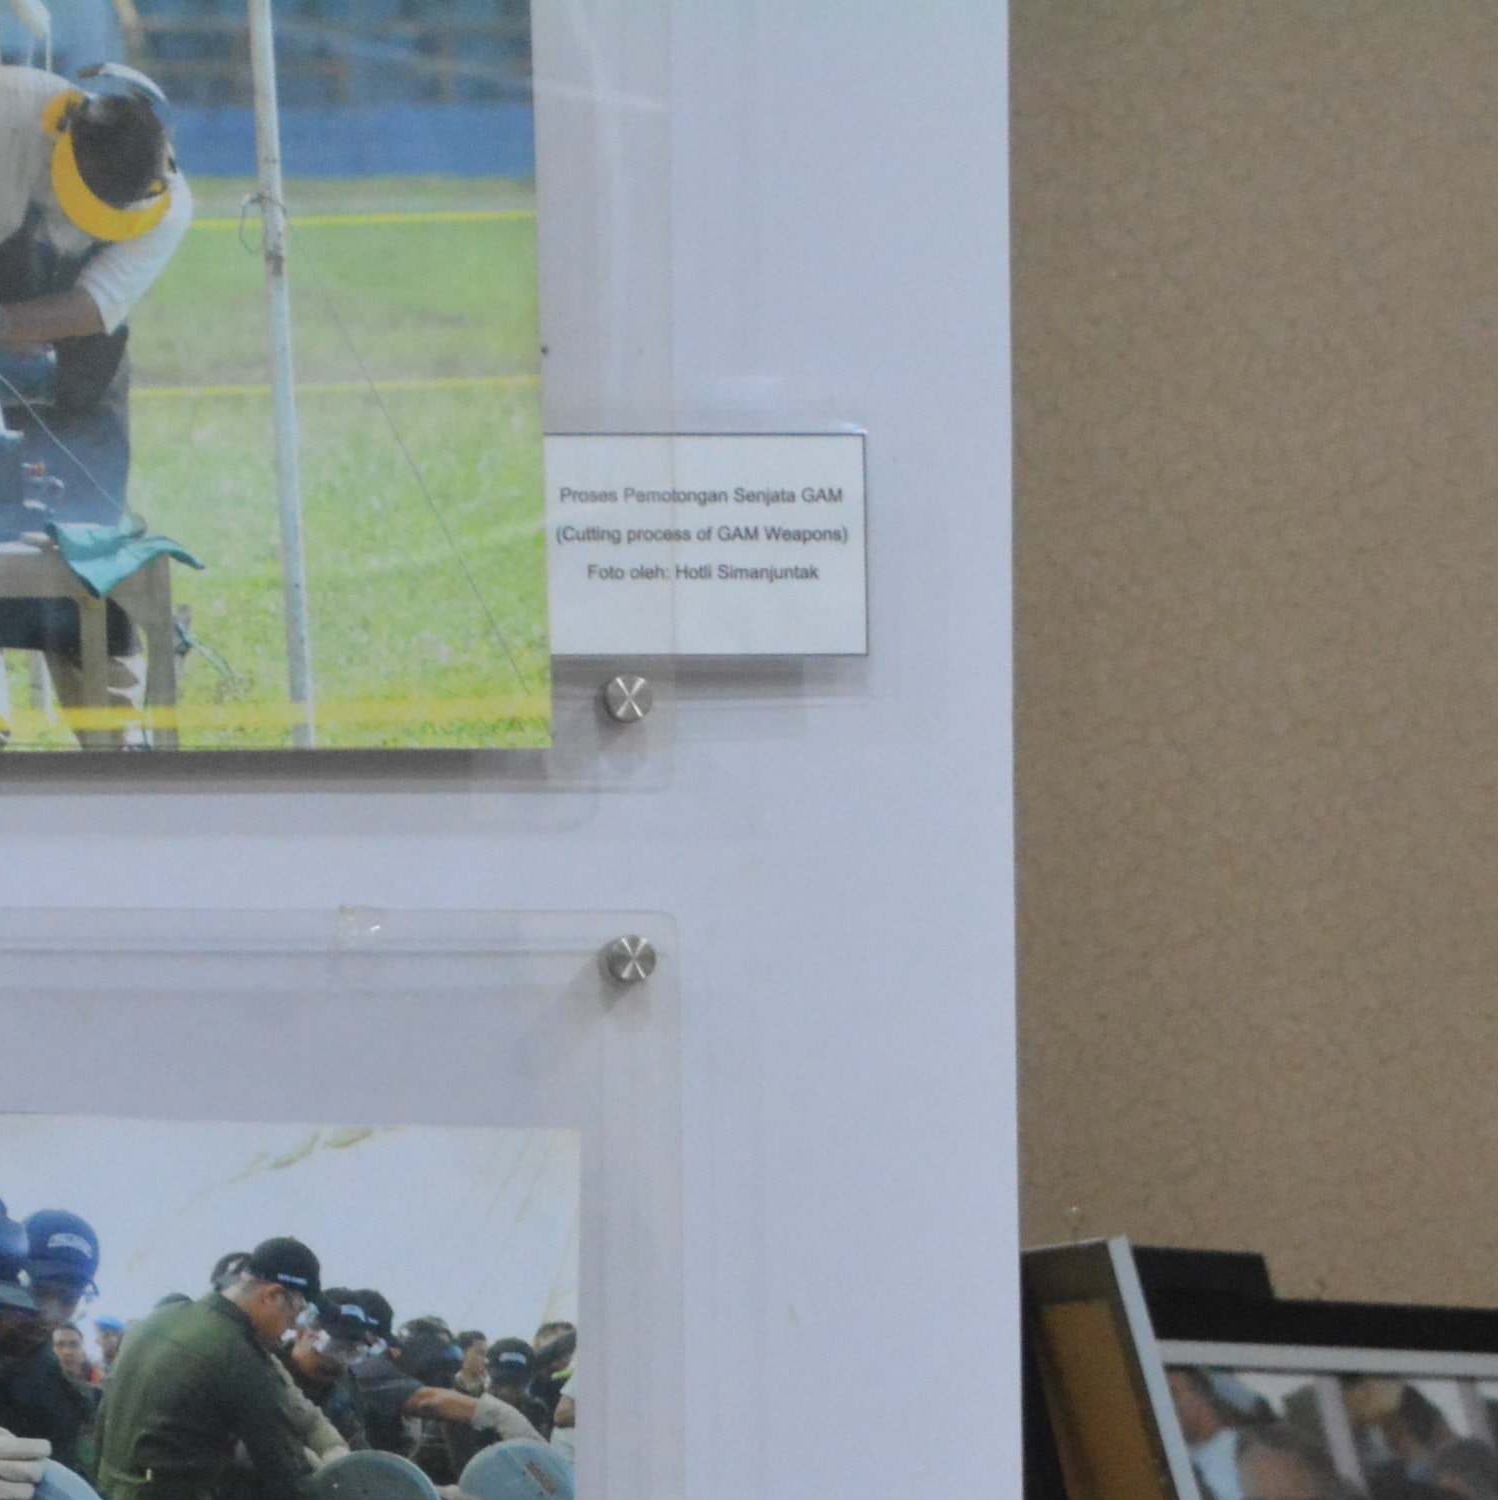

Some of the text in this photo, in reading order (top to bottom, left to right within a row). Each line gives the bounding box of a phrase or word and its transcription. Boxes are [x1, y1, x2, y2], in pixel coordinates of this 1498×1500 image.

[559, 487, 844, 507] Proses Pemotongan Senjata GAM
[555, 525, 849, 545] (Cutting process of GAM Weapons)
[587, 564, 626, 580] Foto
[630, 564, 670, 580] oleh:
[717, 564, 820, 584] Simanjuntak
